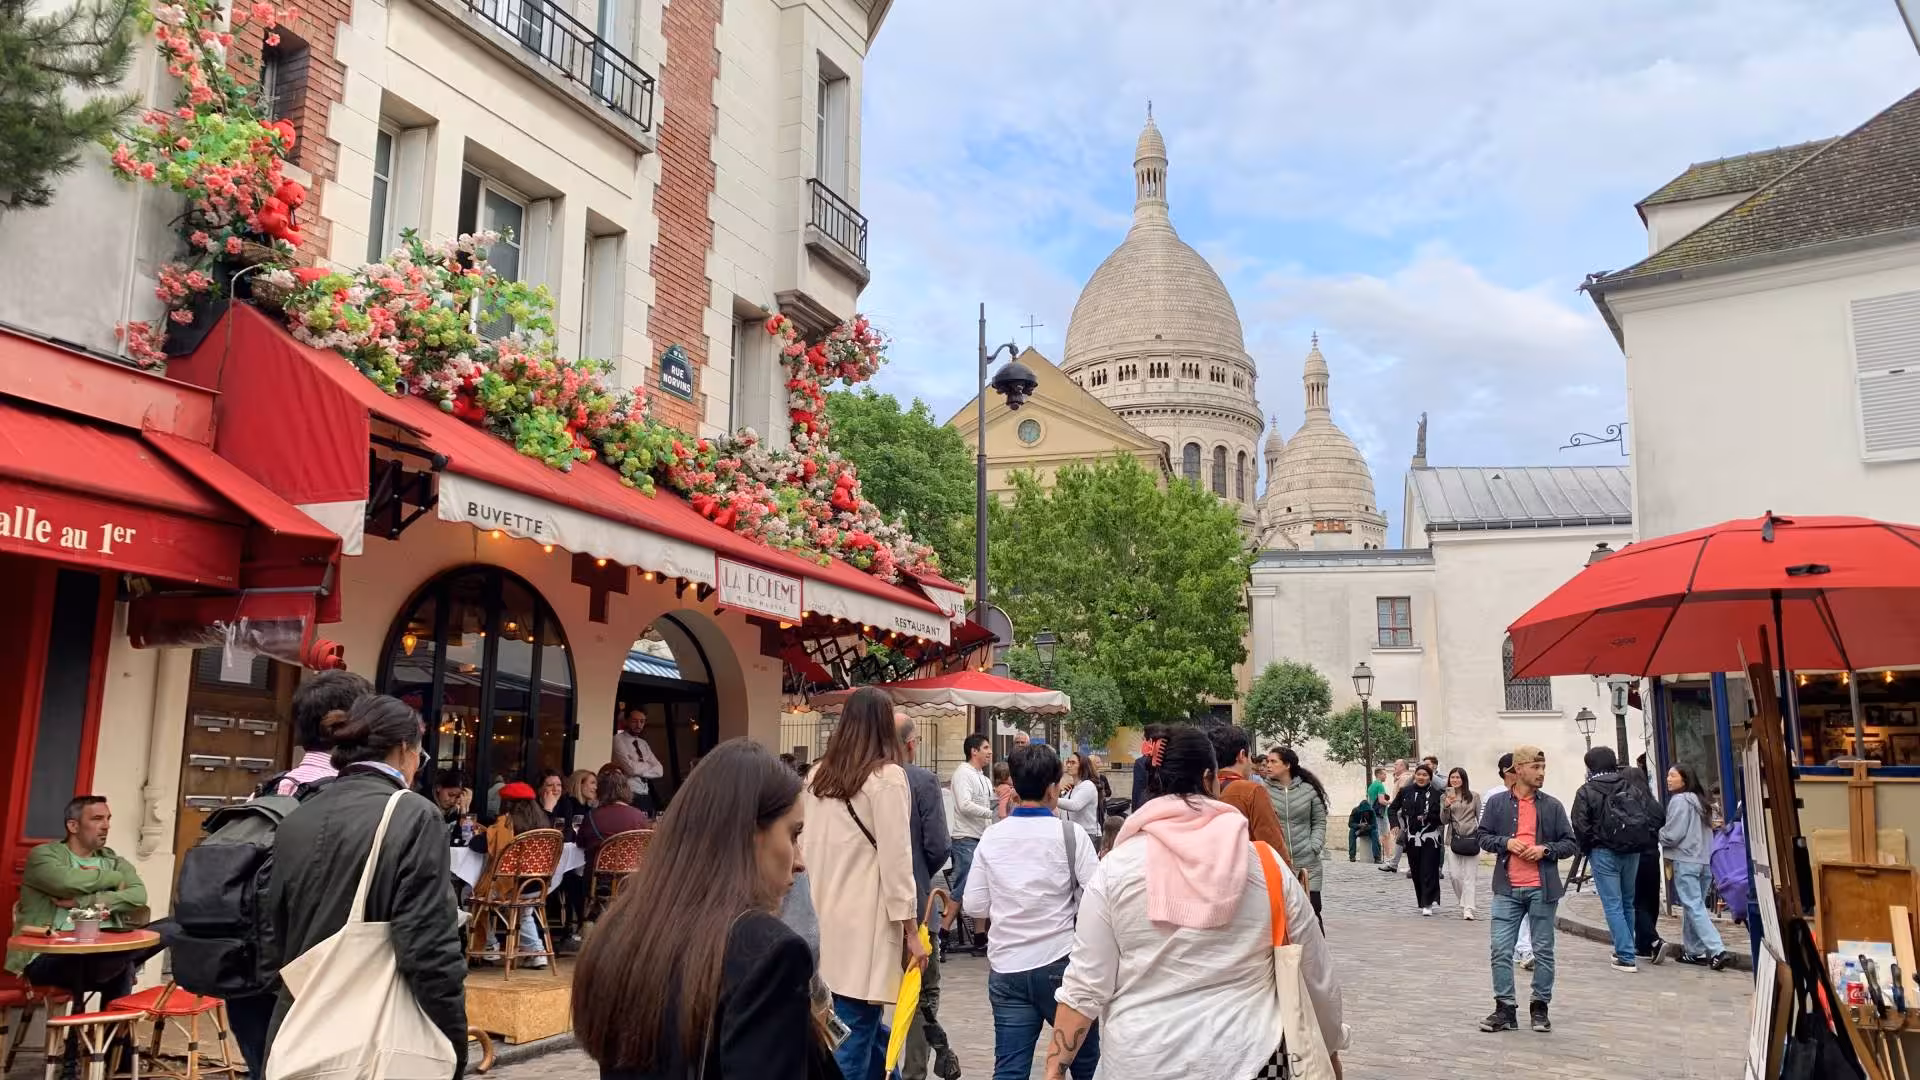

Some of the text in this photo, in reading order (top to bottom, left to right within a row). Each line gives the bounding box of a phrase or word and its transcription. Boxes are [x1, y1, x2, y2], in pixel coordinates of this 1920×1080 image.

[671, 365, 684, 379] RUE
[663, 373, 691, 393] NORVINS
[468, 502, 543, 535] BUVETTE
[0, 505, 137, 555] alle au 1er
[722, 566, 741, 589] LA
[895, 616, 941, 636] RESTAURANT
